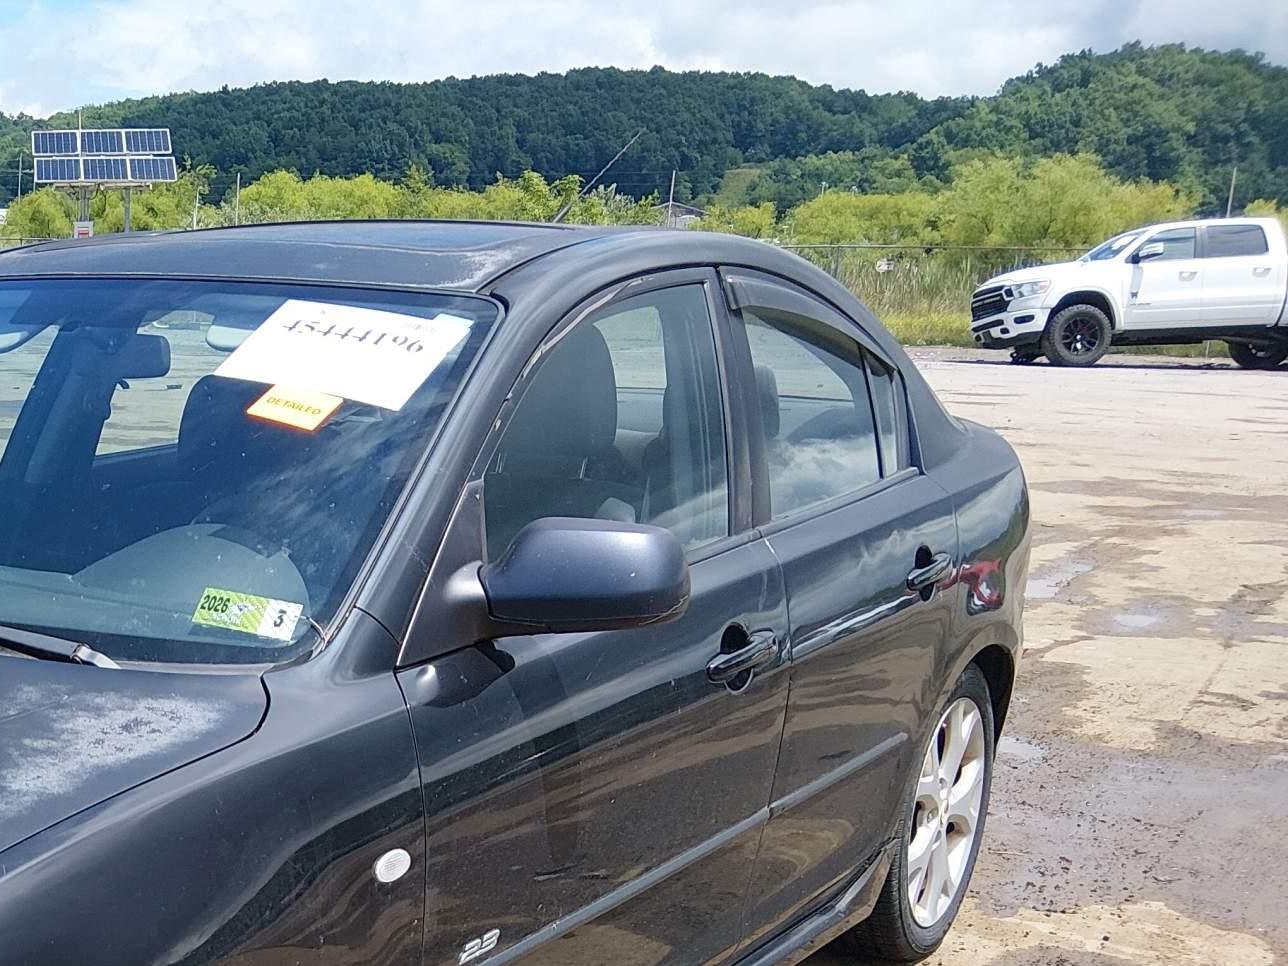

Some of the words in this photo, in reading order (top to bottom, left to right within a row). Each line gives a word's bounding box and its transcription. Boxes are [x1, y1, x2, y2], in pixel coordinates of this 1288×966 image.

[282, 319, 424, 353] 45444196
[266, 396, 322, 416] DETAILED
[199, 594, 231, 614] 2026
[273, 608, 287, 628] 3
